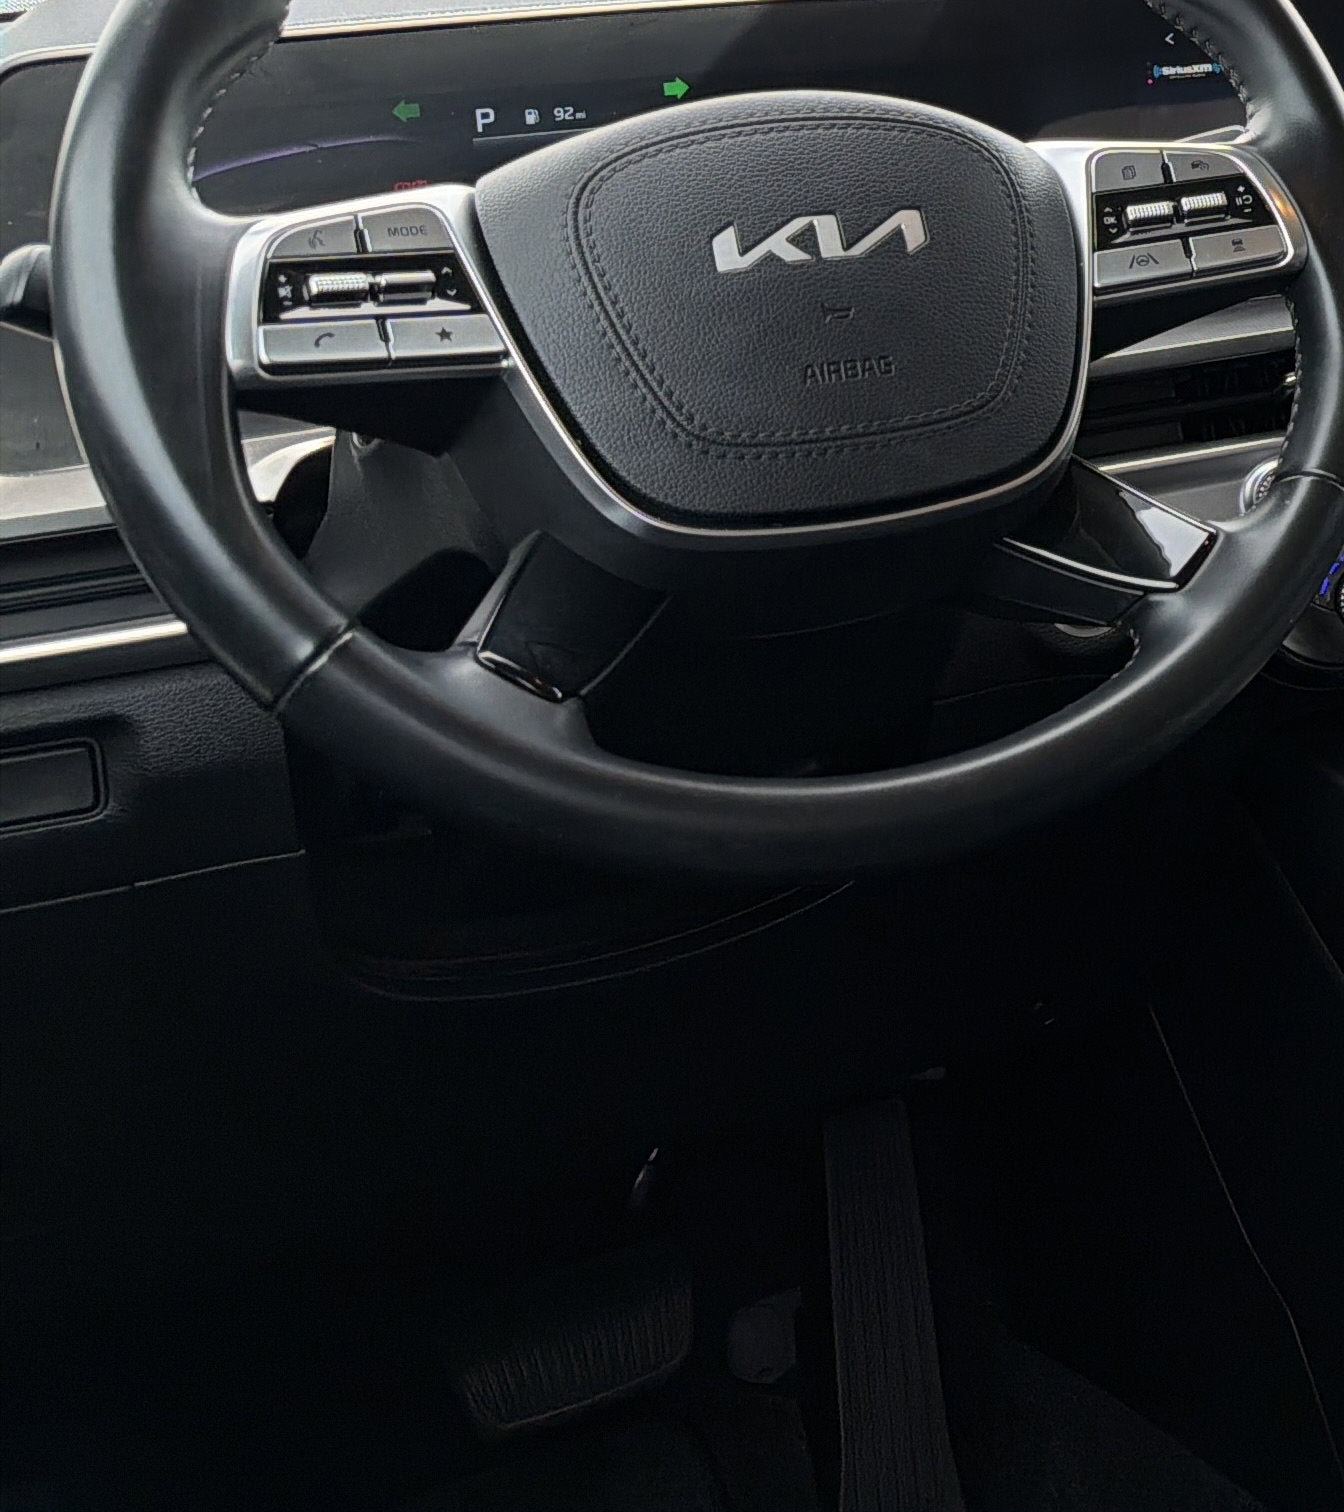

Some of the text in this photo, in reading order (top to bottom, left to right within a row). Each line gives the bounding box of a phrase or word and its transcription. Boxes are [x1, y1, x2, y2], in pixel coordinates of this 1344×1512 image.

[474, 107, 495, 133] P
[553, 106, 587, 121] 92 mi
[1103, 216, 1117, 225] OK
[387, 224, 428, 238] MODE
[711, 208, 929, 273] KIA
[803, 355, 896, 386] AIRBAG
